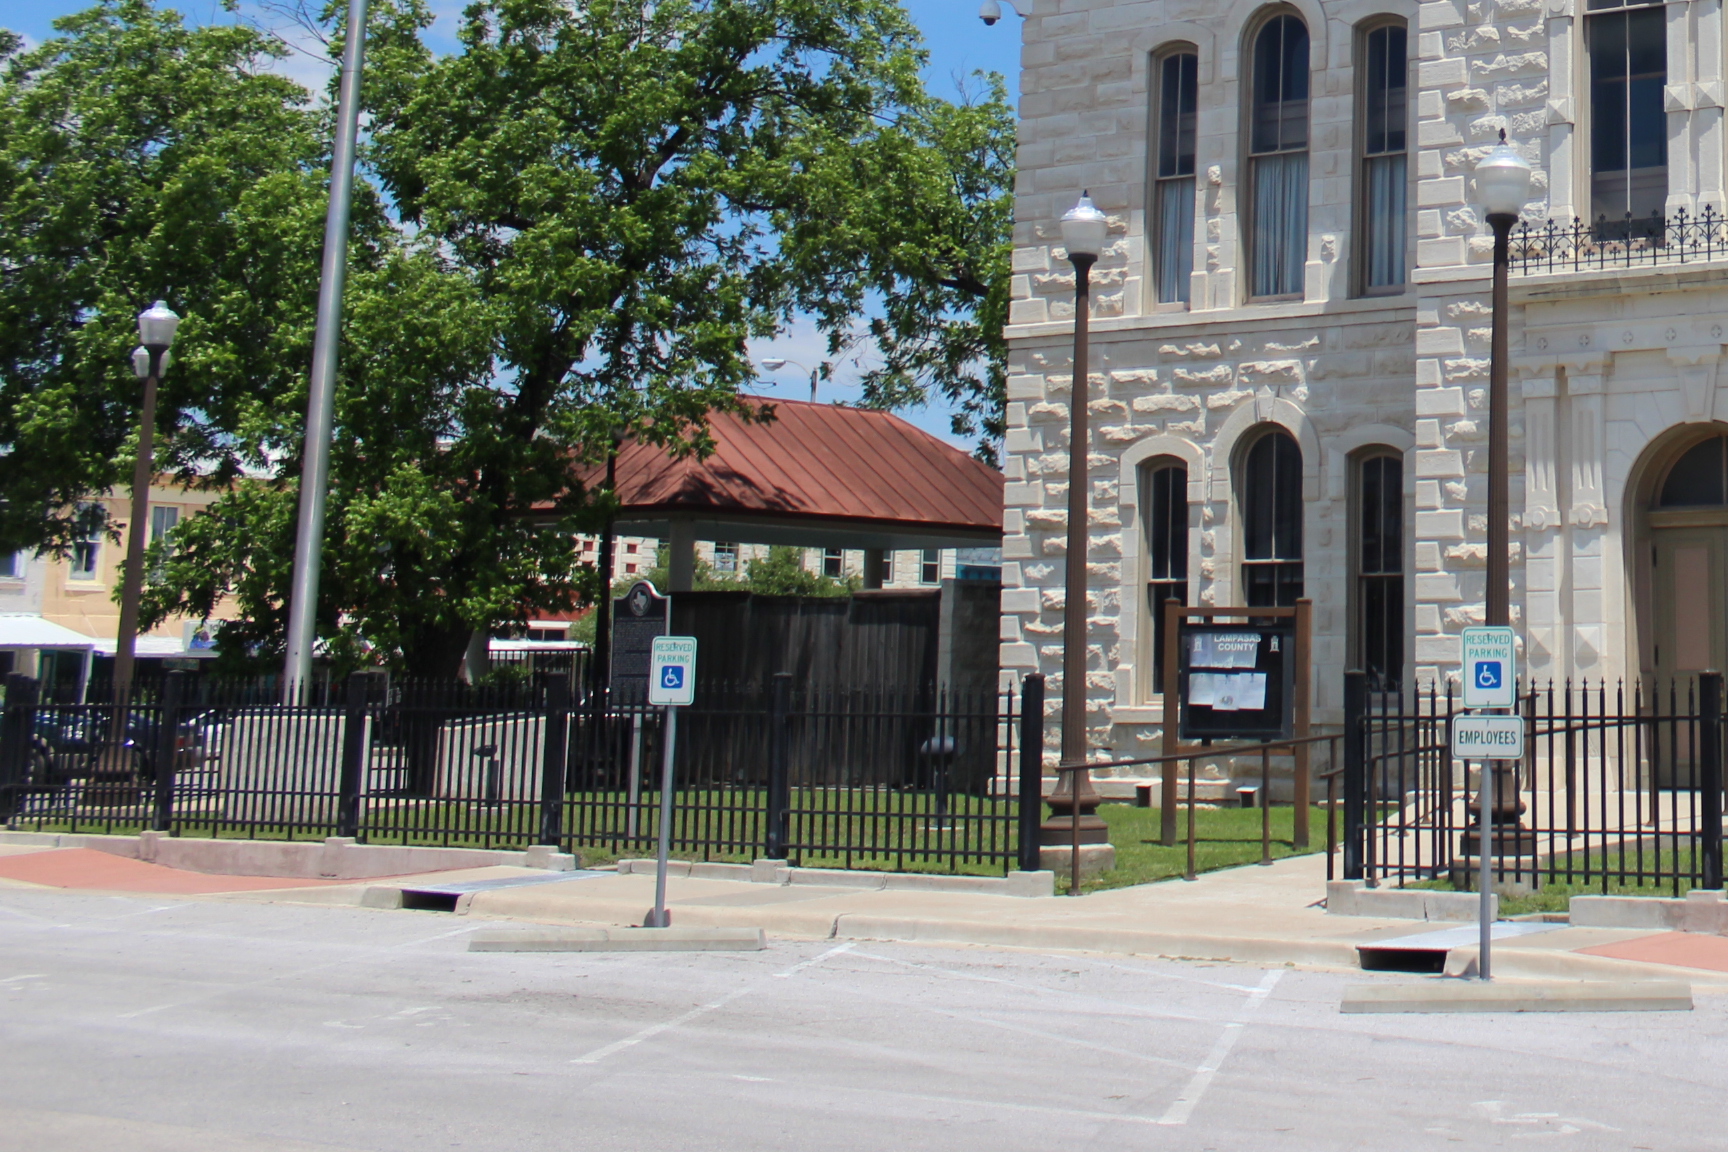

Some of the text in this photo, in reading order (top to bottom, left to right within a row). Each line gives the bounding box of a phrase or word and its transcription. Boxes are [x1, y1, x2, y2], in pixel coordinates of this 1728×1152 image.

[1214, 634, 1261, 642] LAMPASAS
[1466, 634, 1510, 645] RESERVED
[655, 643, 692, 652] RESERVED
[1218, 643, 1254, 651] COUNTY
[1469, 648, 1507, 658] PARKING
[657, 654, 689, 663] PARKING
[1459, 730, 1516, 744] EMPLOYEES
